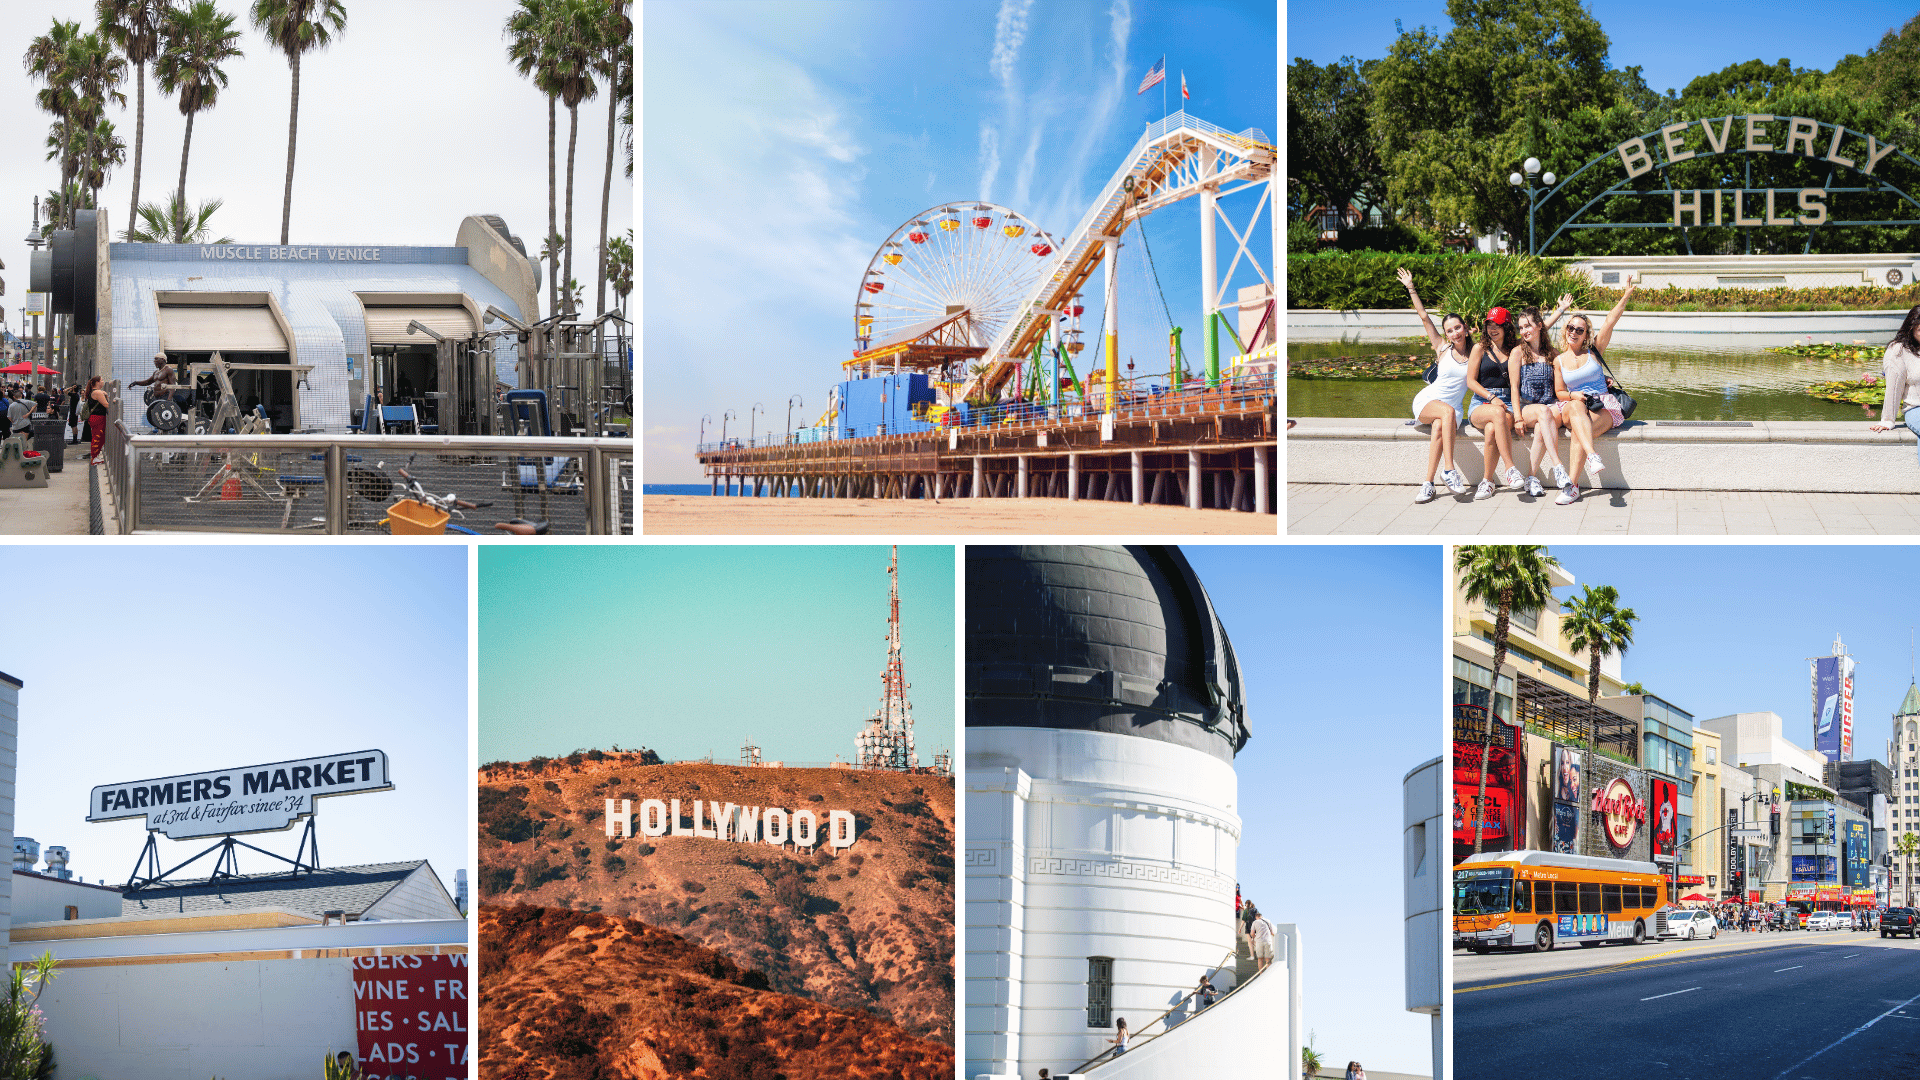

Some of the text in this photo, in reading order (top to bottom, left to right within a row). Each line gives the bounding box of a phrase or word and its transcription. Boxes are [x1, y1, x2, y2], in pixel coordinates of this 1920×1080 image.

[1617, 114, 1896, 179] BEVERLY
[1674, 188, 1827, 226] HILLS
[200, 246, 381, 261] MUSCLE BEACH VENICE
[1460, 706, 1485, 720] TCL
[1453, 718, 1501, 734] HINEE
[1453, 729, 1505, 746] EATES
[101, 756, 376, 813] FARMERS MARKET
[1470, 795, 1502, 808] TCL
[1591, 787, 1647, 824] Hard Rock
[153, 808, 169, 824] at
[167, 807, 191, 825] 3rd
[191, 805, 201, 820] &
[200, 800, 248, 823] Fairfax
[248, 798, 283, 813] since
[1470, 806, 1501, 816] CNESE
[605, 798, 856, 848] HOLLYWOOD
[1614, 824, 1629, 837] CAFE
[1457, 870, 1469, 879] 217
[1533, 871, 1547, 879] Metro
[1547, 872, 1559, 880] Local
[1607, 920, 1634, 939] Metro
[434, 979, 467, 1000] FR
[417, 1010, 467, 1032] SAL
